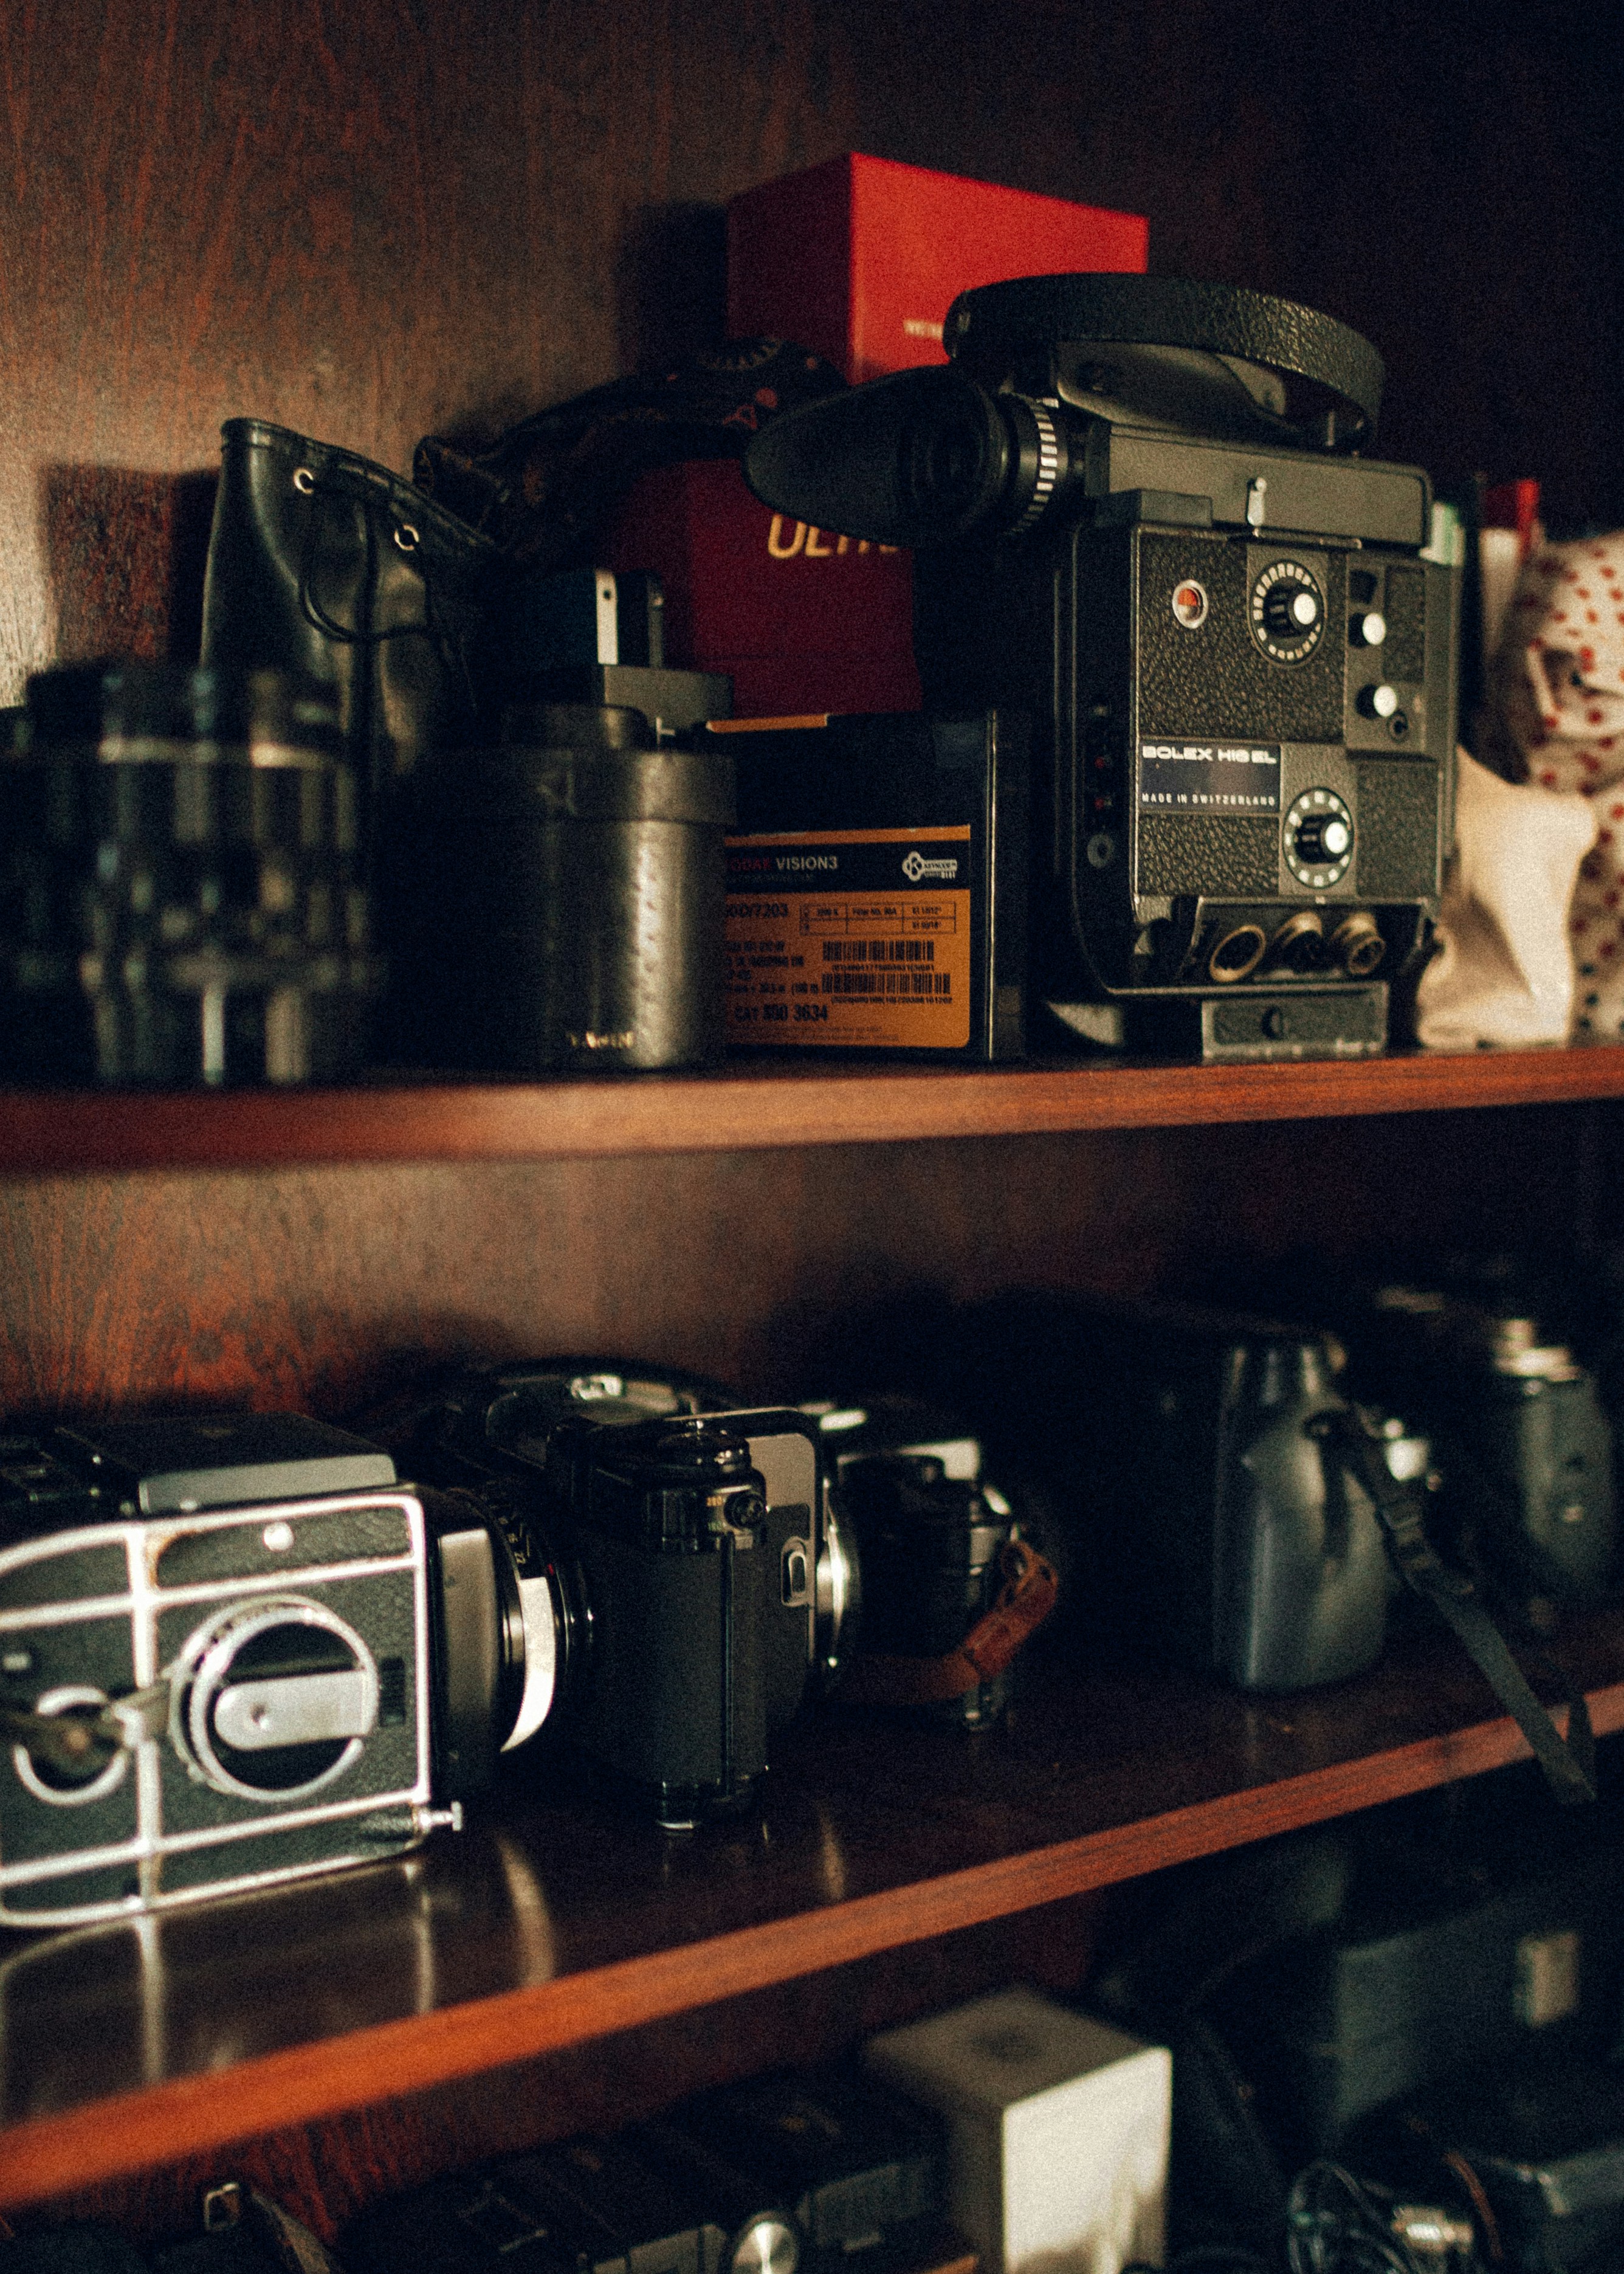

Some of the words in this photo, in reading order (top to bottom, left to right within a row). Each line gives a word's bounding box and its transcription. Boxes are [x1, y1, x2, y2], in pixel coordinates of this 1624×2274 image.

[1142, 746, 1213, 761] BOLEX
[1141, 793, 1172, 804] MADE
[1177, 793, 1188, 804] IN
[1192, 794, 1276, 807] SWITZERLAND
[775, 855, 839, 870] VISION3
[734, 1005, 759, 1022] CAT
[793, 1004, 828, 1022] 3634
